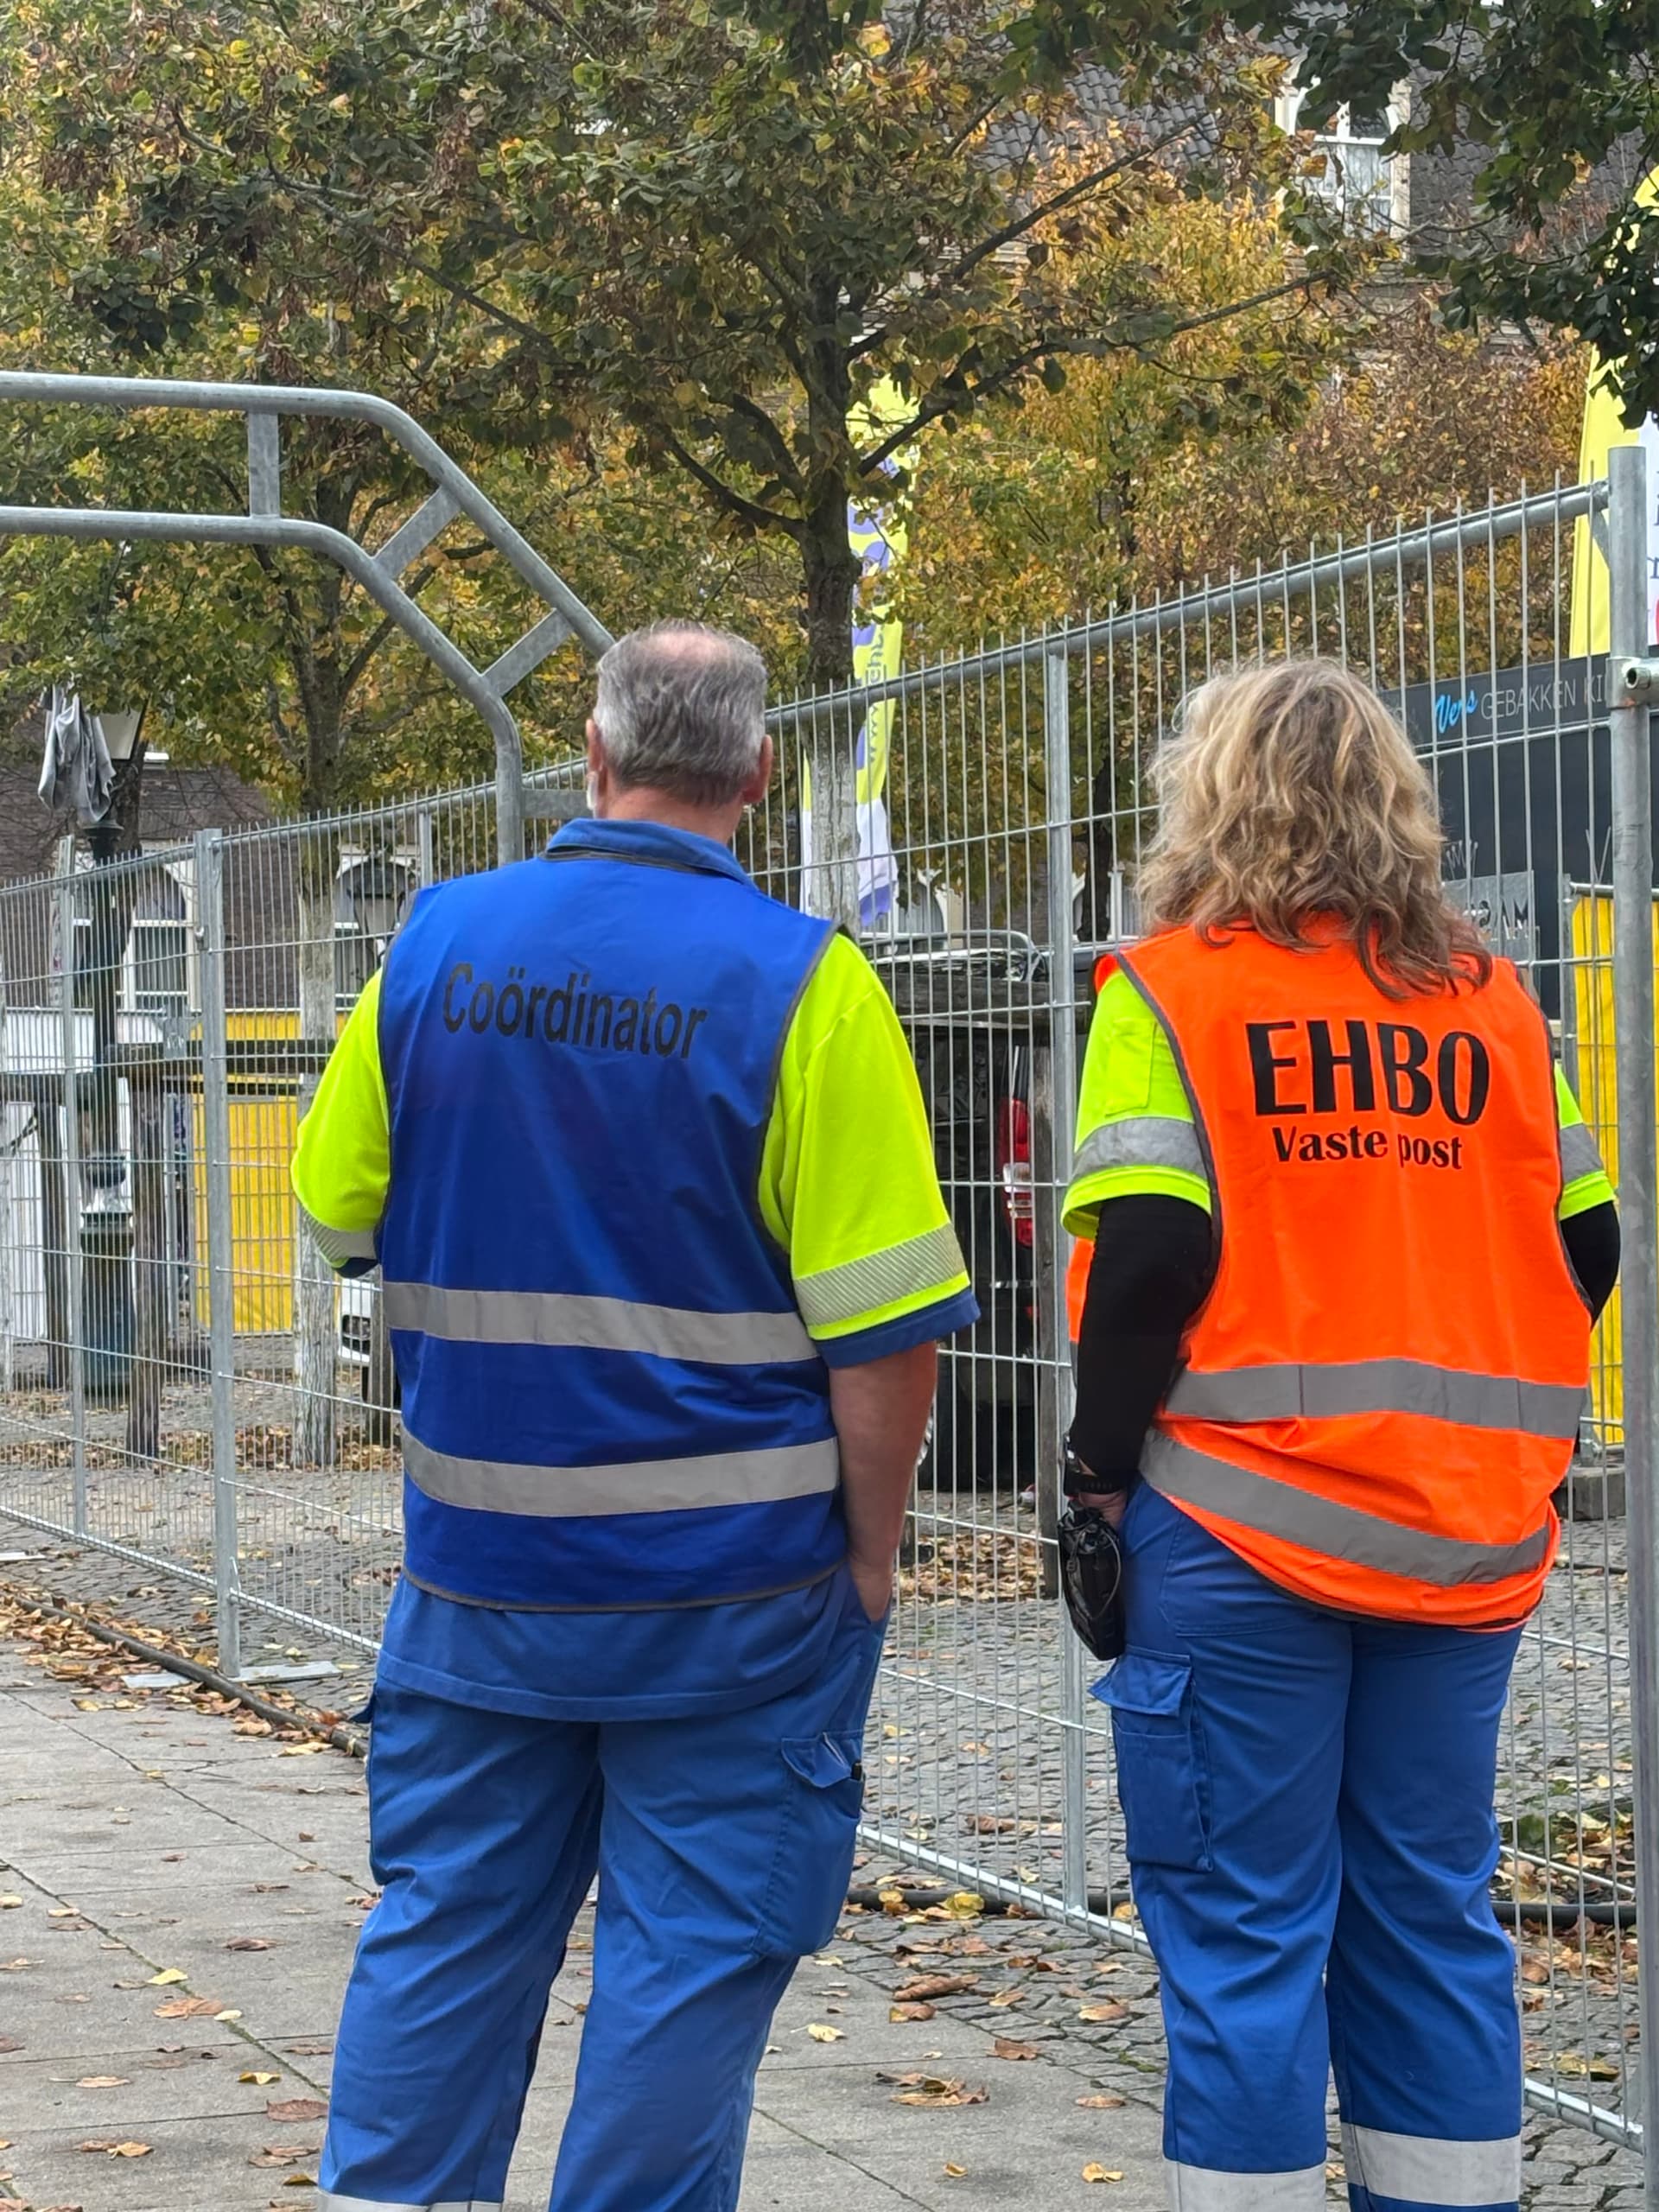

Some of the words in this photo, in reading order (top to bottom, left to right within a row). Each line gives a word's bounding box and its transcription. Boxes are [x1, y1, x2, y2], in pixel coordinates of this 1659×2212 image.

[1434, 690, 1478, 734] Vers
[1480, 677, 1577, 721] GEBAKKEN
[1583, 674, 1604, 705] KI
[442, 963, 709, 1059] Coördinator
[1245, 1020, 1491, 1126] EHBO
[1272, 1125, 1389, 1162] Vaste
[1397, 1133, 1463, 1170] post
